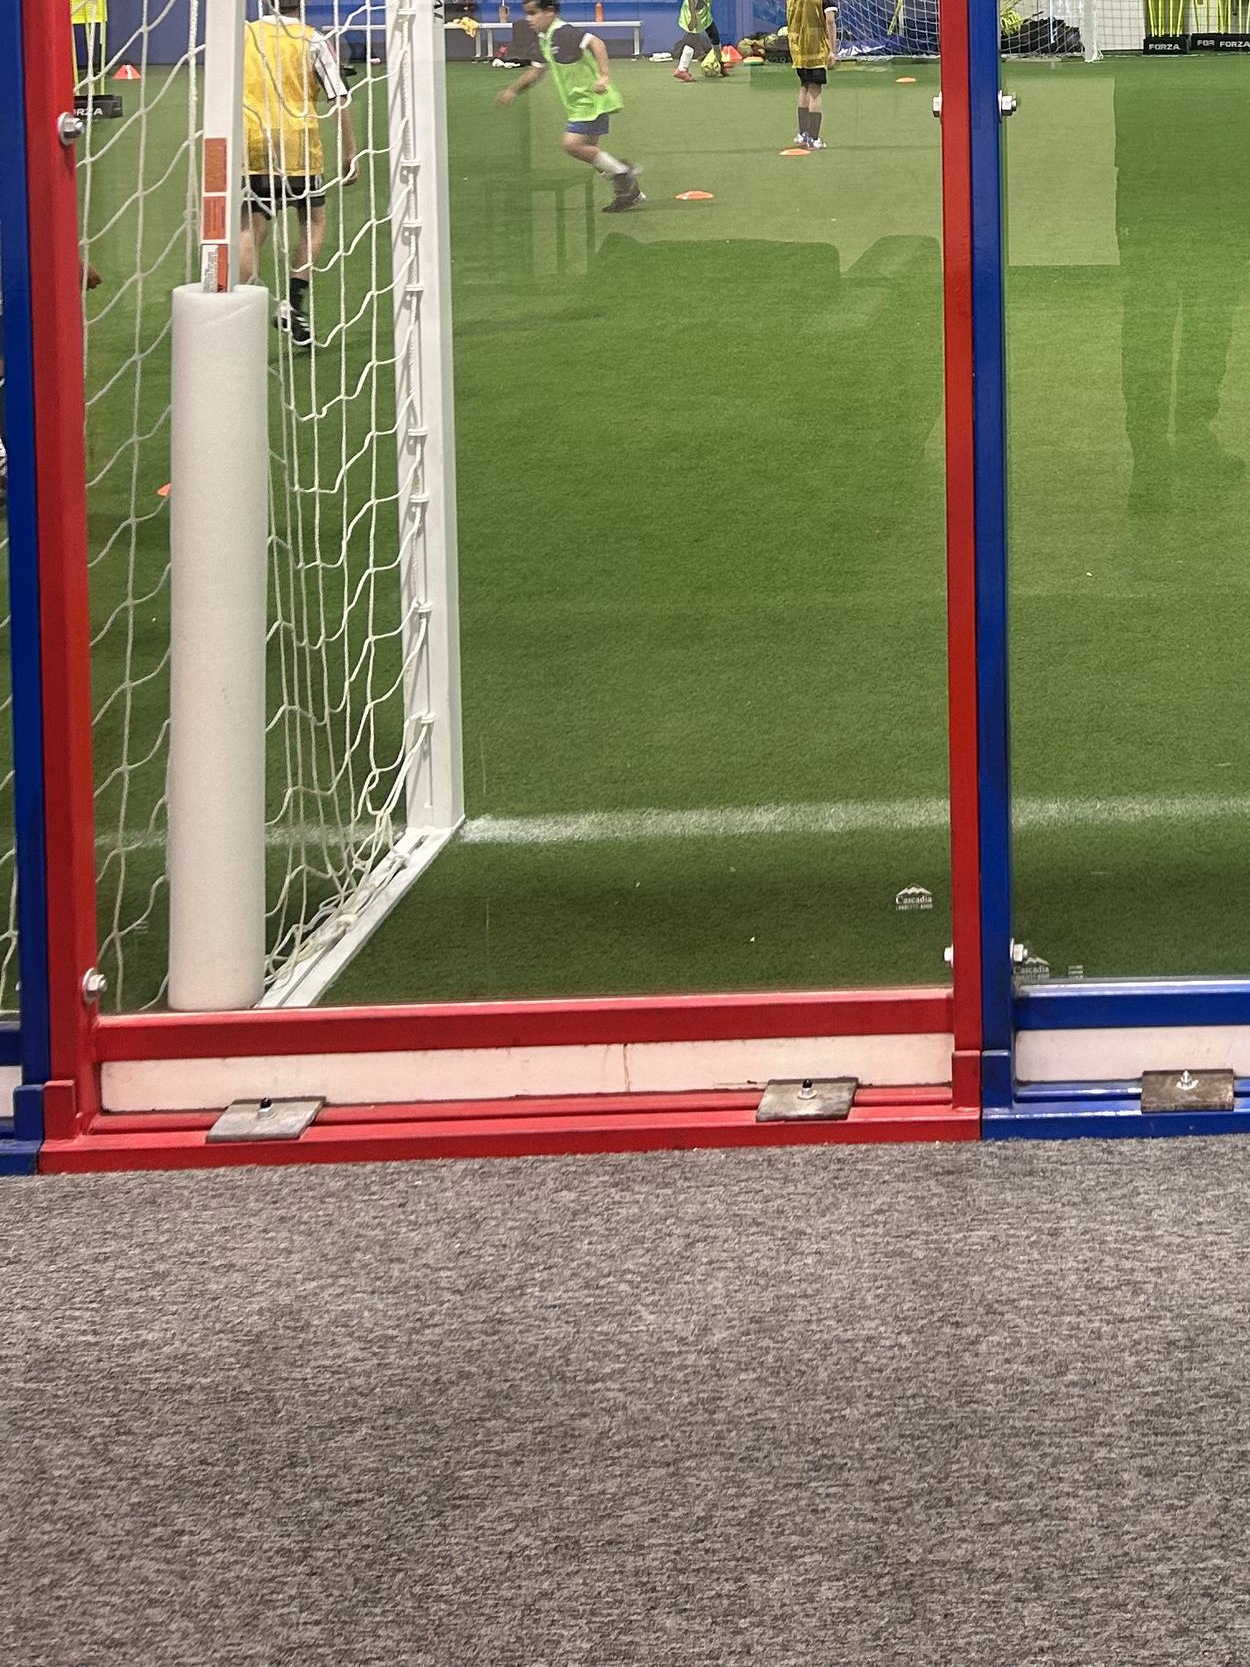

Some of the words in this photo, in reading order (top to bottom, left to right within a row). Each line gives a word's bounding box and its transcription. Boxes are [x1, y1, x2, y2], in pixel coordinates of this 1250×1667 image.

[1148, 43, 1181, 51] FORZA
[1197, 39, 1215, 47] FOR
[1219, 40, 1250, 48] FORZA
[895, 895, 933, 905] Cascadia
[1013, 965, 1050, 974] Cascadia
